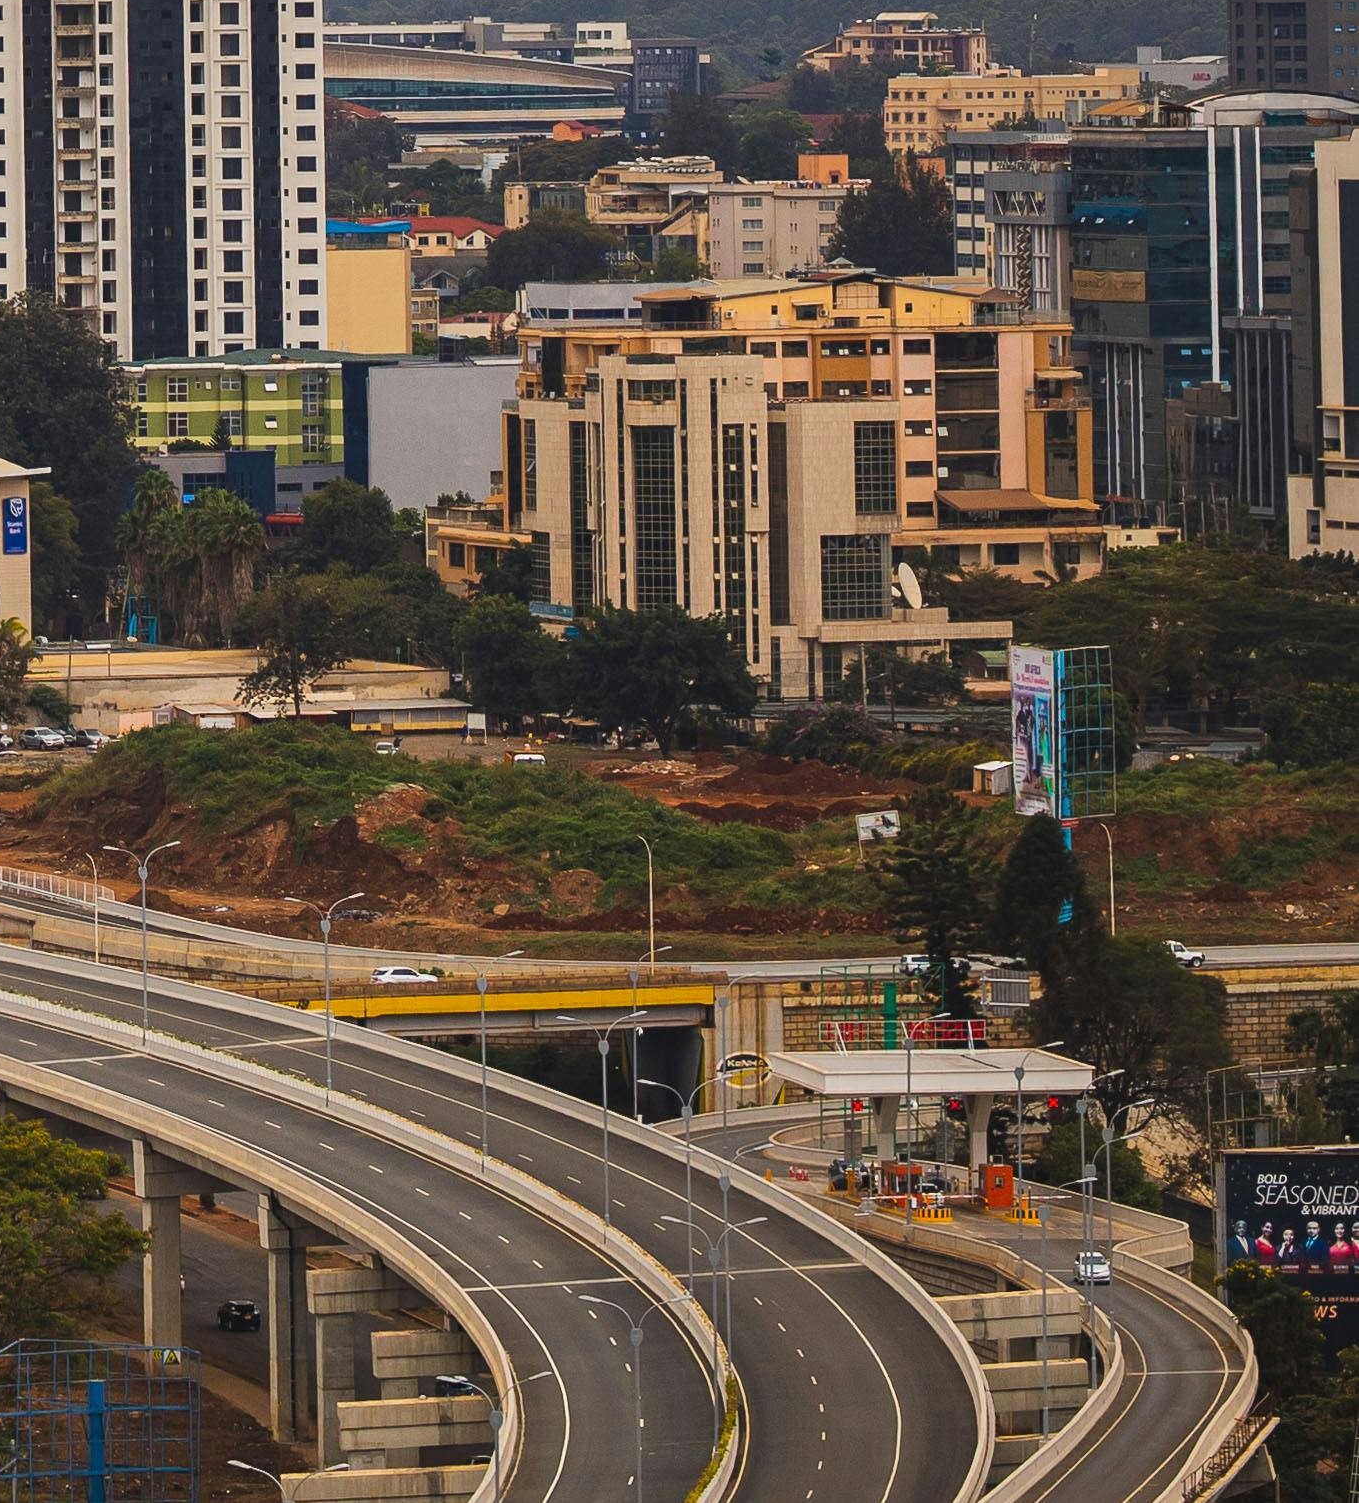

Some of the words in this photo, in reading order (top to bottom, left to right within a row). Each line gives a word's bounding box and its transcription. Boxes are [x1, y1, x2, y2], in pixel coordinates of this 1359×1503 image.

[1257, 1174, 1287, 1184] BOLD
[1254, 1185, 1359, 1206] SEASONED
[1301, 1205, 1310, 1215] &
[1311, 1205, 1359, 1215] VIBRANT
